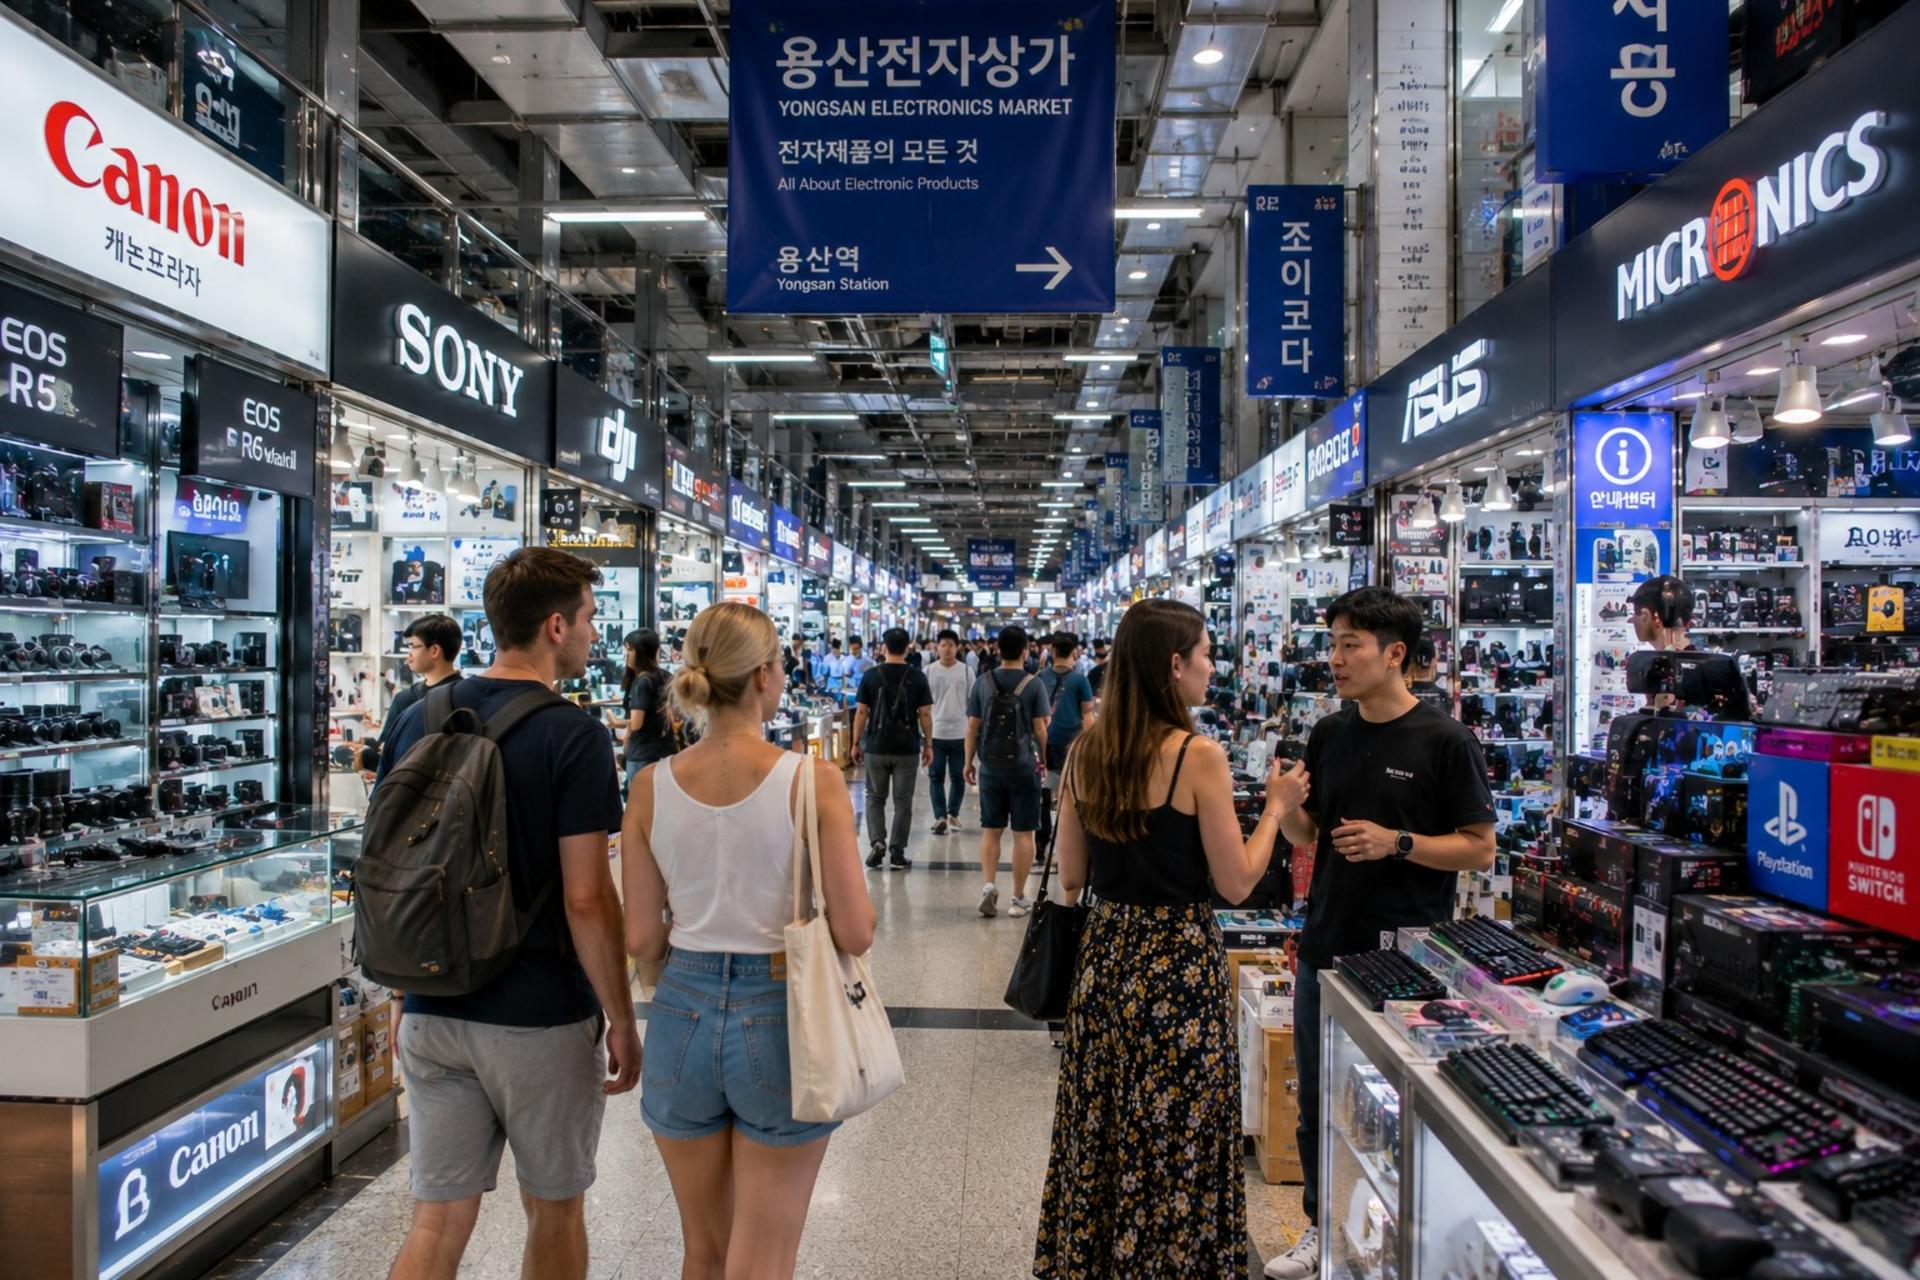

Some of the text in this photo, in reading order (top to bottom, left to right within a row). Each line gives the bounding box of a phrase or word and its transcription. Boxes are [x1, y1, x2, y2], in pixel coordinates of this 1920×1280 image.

[776, 35, 1076, 90] 용산전자상가
[778, 98, 1073, 117] YONGSAN ELECTRONICS MARKET
[778, 138, 977, 165] 전자제품의 모든 것
[44, 100, 245, 267] Canon
[777, 176, 979, 191] All About Electronic Products
[104, 226, 201, 297] 캐논프라자
[776, 245, 860, 274] 용산역
[776, 277, 889, 293] Yongsan Station
[1280, 221, 1313, 374] 조이코다
[1, 316, 68, 368] EOS
[398, 303, 525, 419] SONY
[9, 361, 57, 412] R5
[1401, 338, 1488, 444] ASUS
[243, 398, 281, 433] EOS
[242, 430, 264, 462] R6
[1847, 874, 1905, 905] SWITCH
